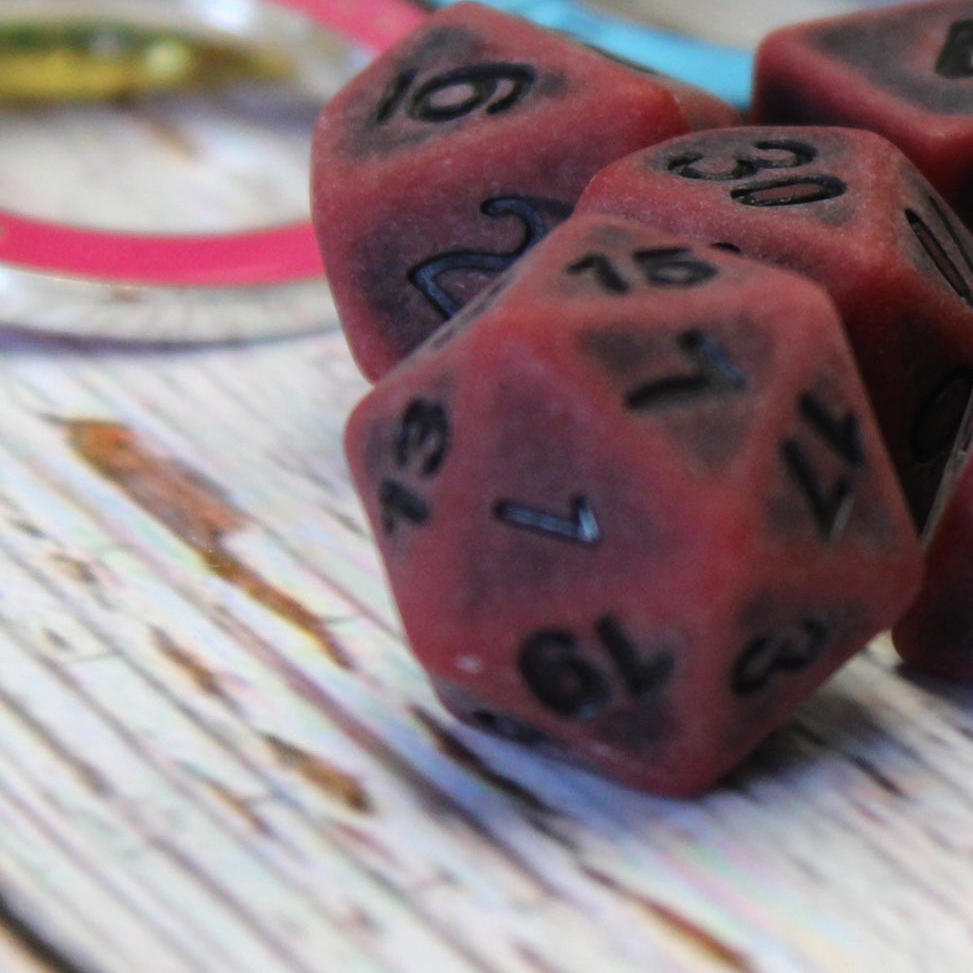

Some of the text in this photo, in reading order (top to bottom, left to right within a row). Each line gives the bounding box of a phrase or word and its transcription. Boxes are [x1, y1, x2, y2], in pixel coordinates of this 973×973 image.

[666, 139, 848, 208] 30
[566, 246, 719, 296] 15
[378, 397, 449, 535] 13
[779, 391, 866, 544] 17
[519, 615, 676, 721] 19
